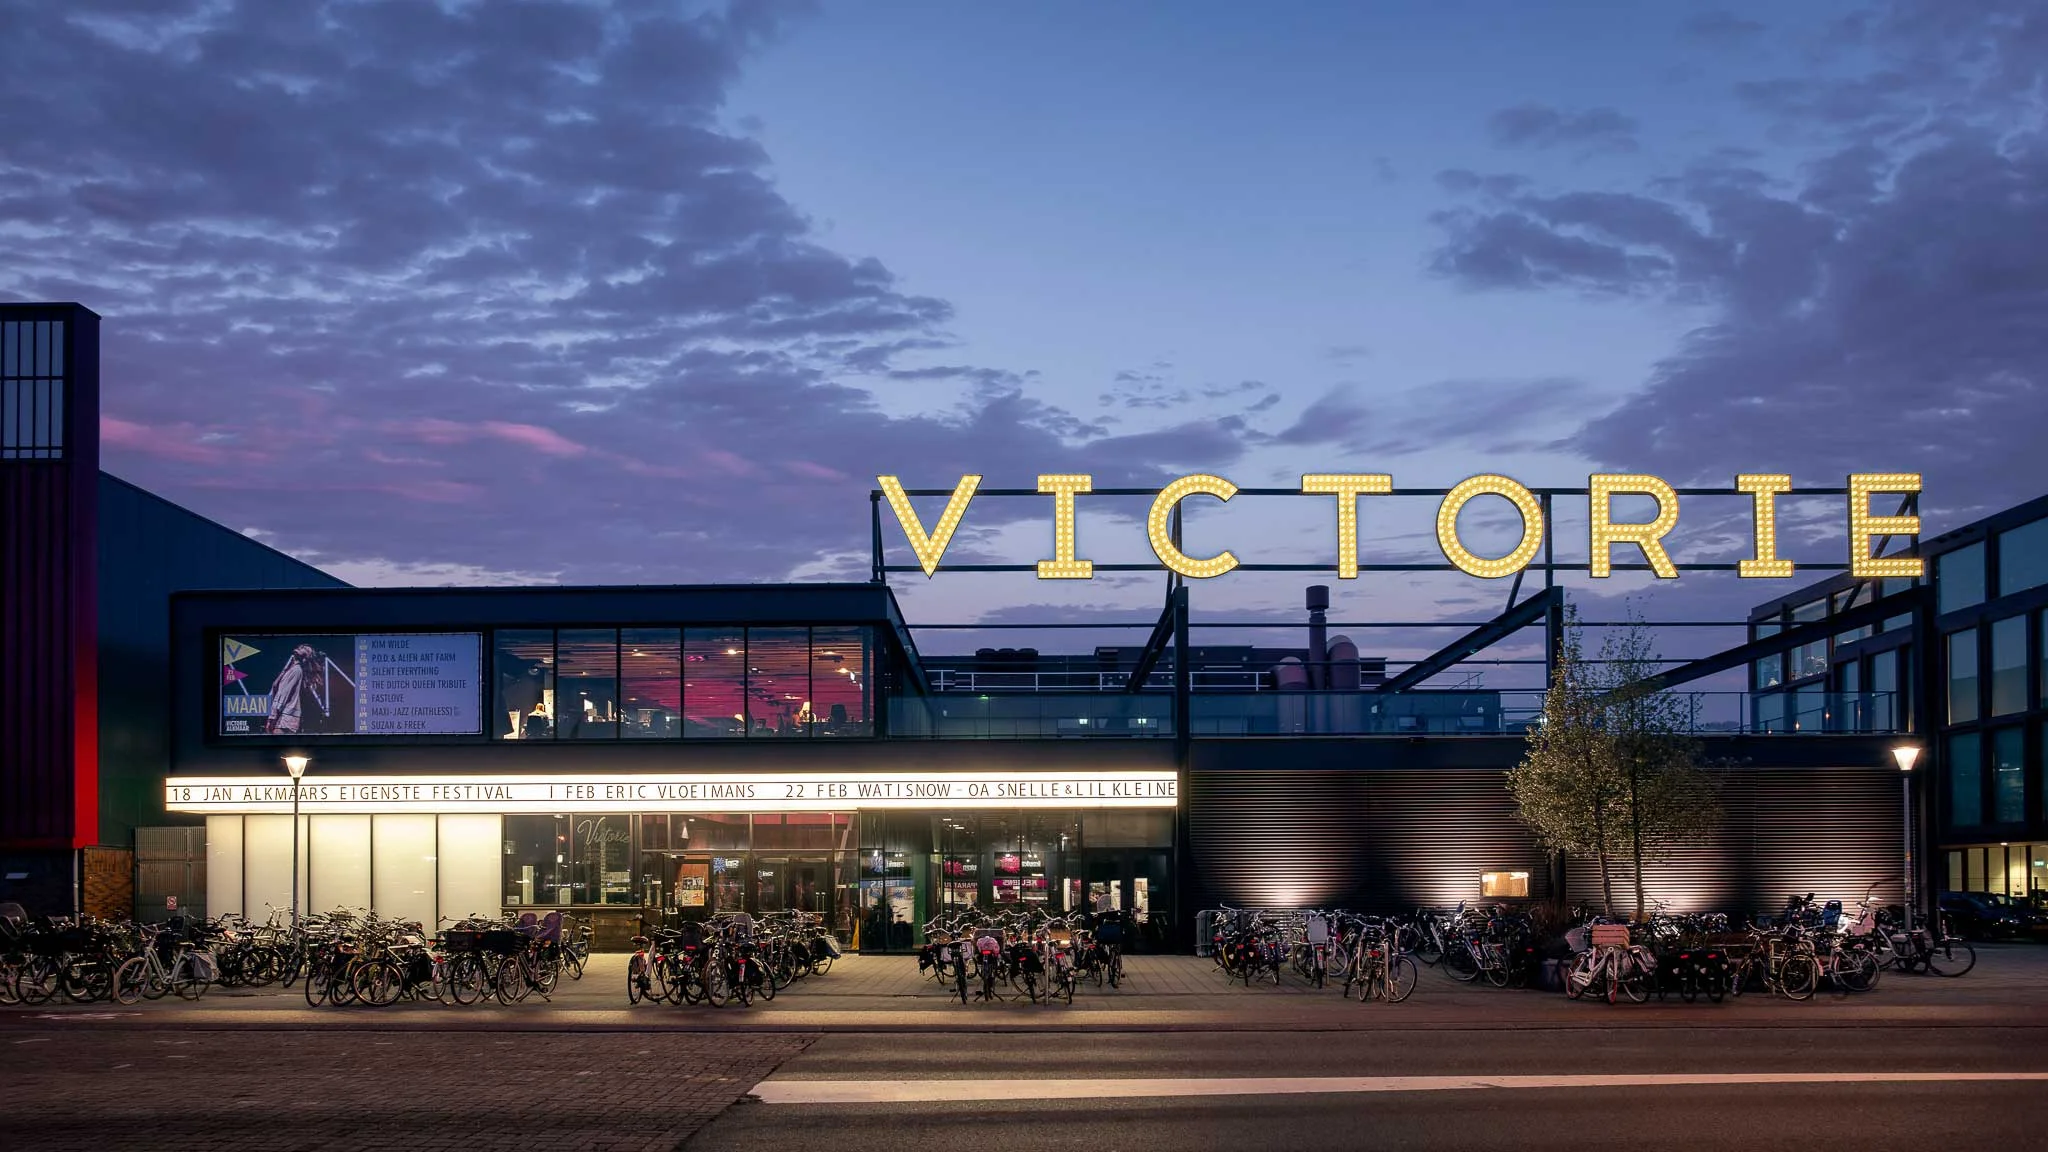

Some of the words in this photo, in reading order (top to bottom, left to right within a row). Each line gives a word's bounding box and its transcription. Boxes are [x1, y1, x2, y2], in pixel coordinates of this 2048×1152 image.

[877, 473, 1924, 579] VICTORIE
[372, 640, 386, 649] KIM
[388, 640, 409, 648] WILDE
[398, 654, 417, 662] ALIEN
[420, 654, 434, 662] ANT
[436, 653, 456, 662] FARM
[371, 667, 394, 676] SILENT
[397, 667, 440, 676] EVERYTHING
[372, 680, 384, 689] THE
[387, 680, 409, 689] DUTCH
[412, 680, 435, 689] QUEEN
[438, 680, 466, 688] TRIBUTE
[372, 694, 404, 702] FASTLOVE
[228, 697, 267, 714] MAAN
[411, 707, 452, 716] (FAITHLESS)
[371, 721, 394, 729] SUZAN
[404, 720, 426, 729] FREEK
[172, 788, 191, 801] 18
[204, 788, 232, 801] JAN
[340, 786, 420, 800] EIGENSTE
[433, 786, 513, 799] FESTIVAL
[566, 786, 594, 799] FEB
[607, 785, 646, 799] ERIC
[658, 785, 755, 798] VLOEIMANS
[786, 785, 804, 797] 22
[817, 784, 847, 797] FEB
[969, 784, 989, 797] OA
[1113, 782, 1175, 796] KLEINE
